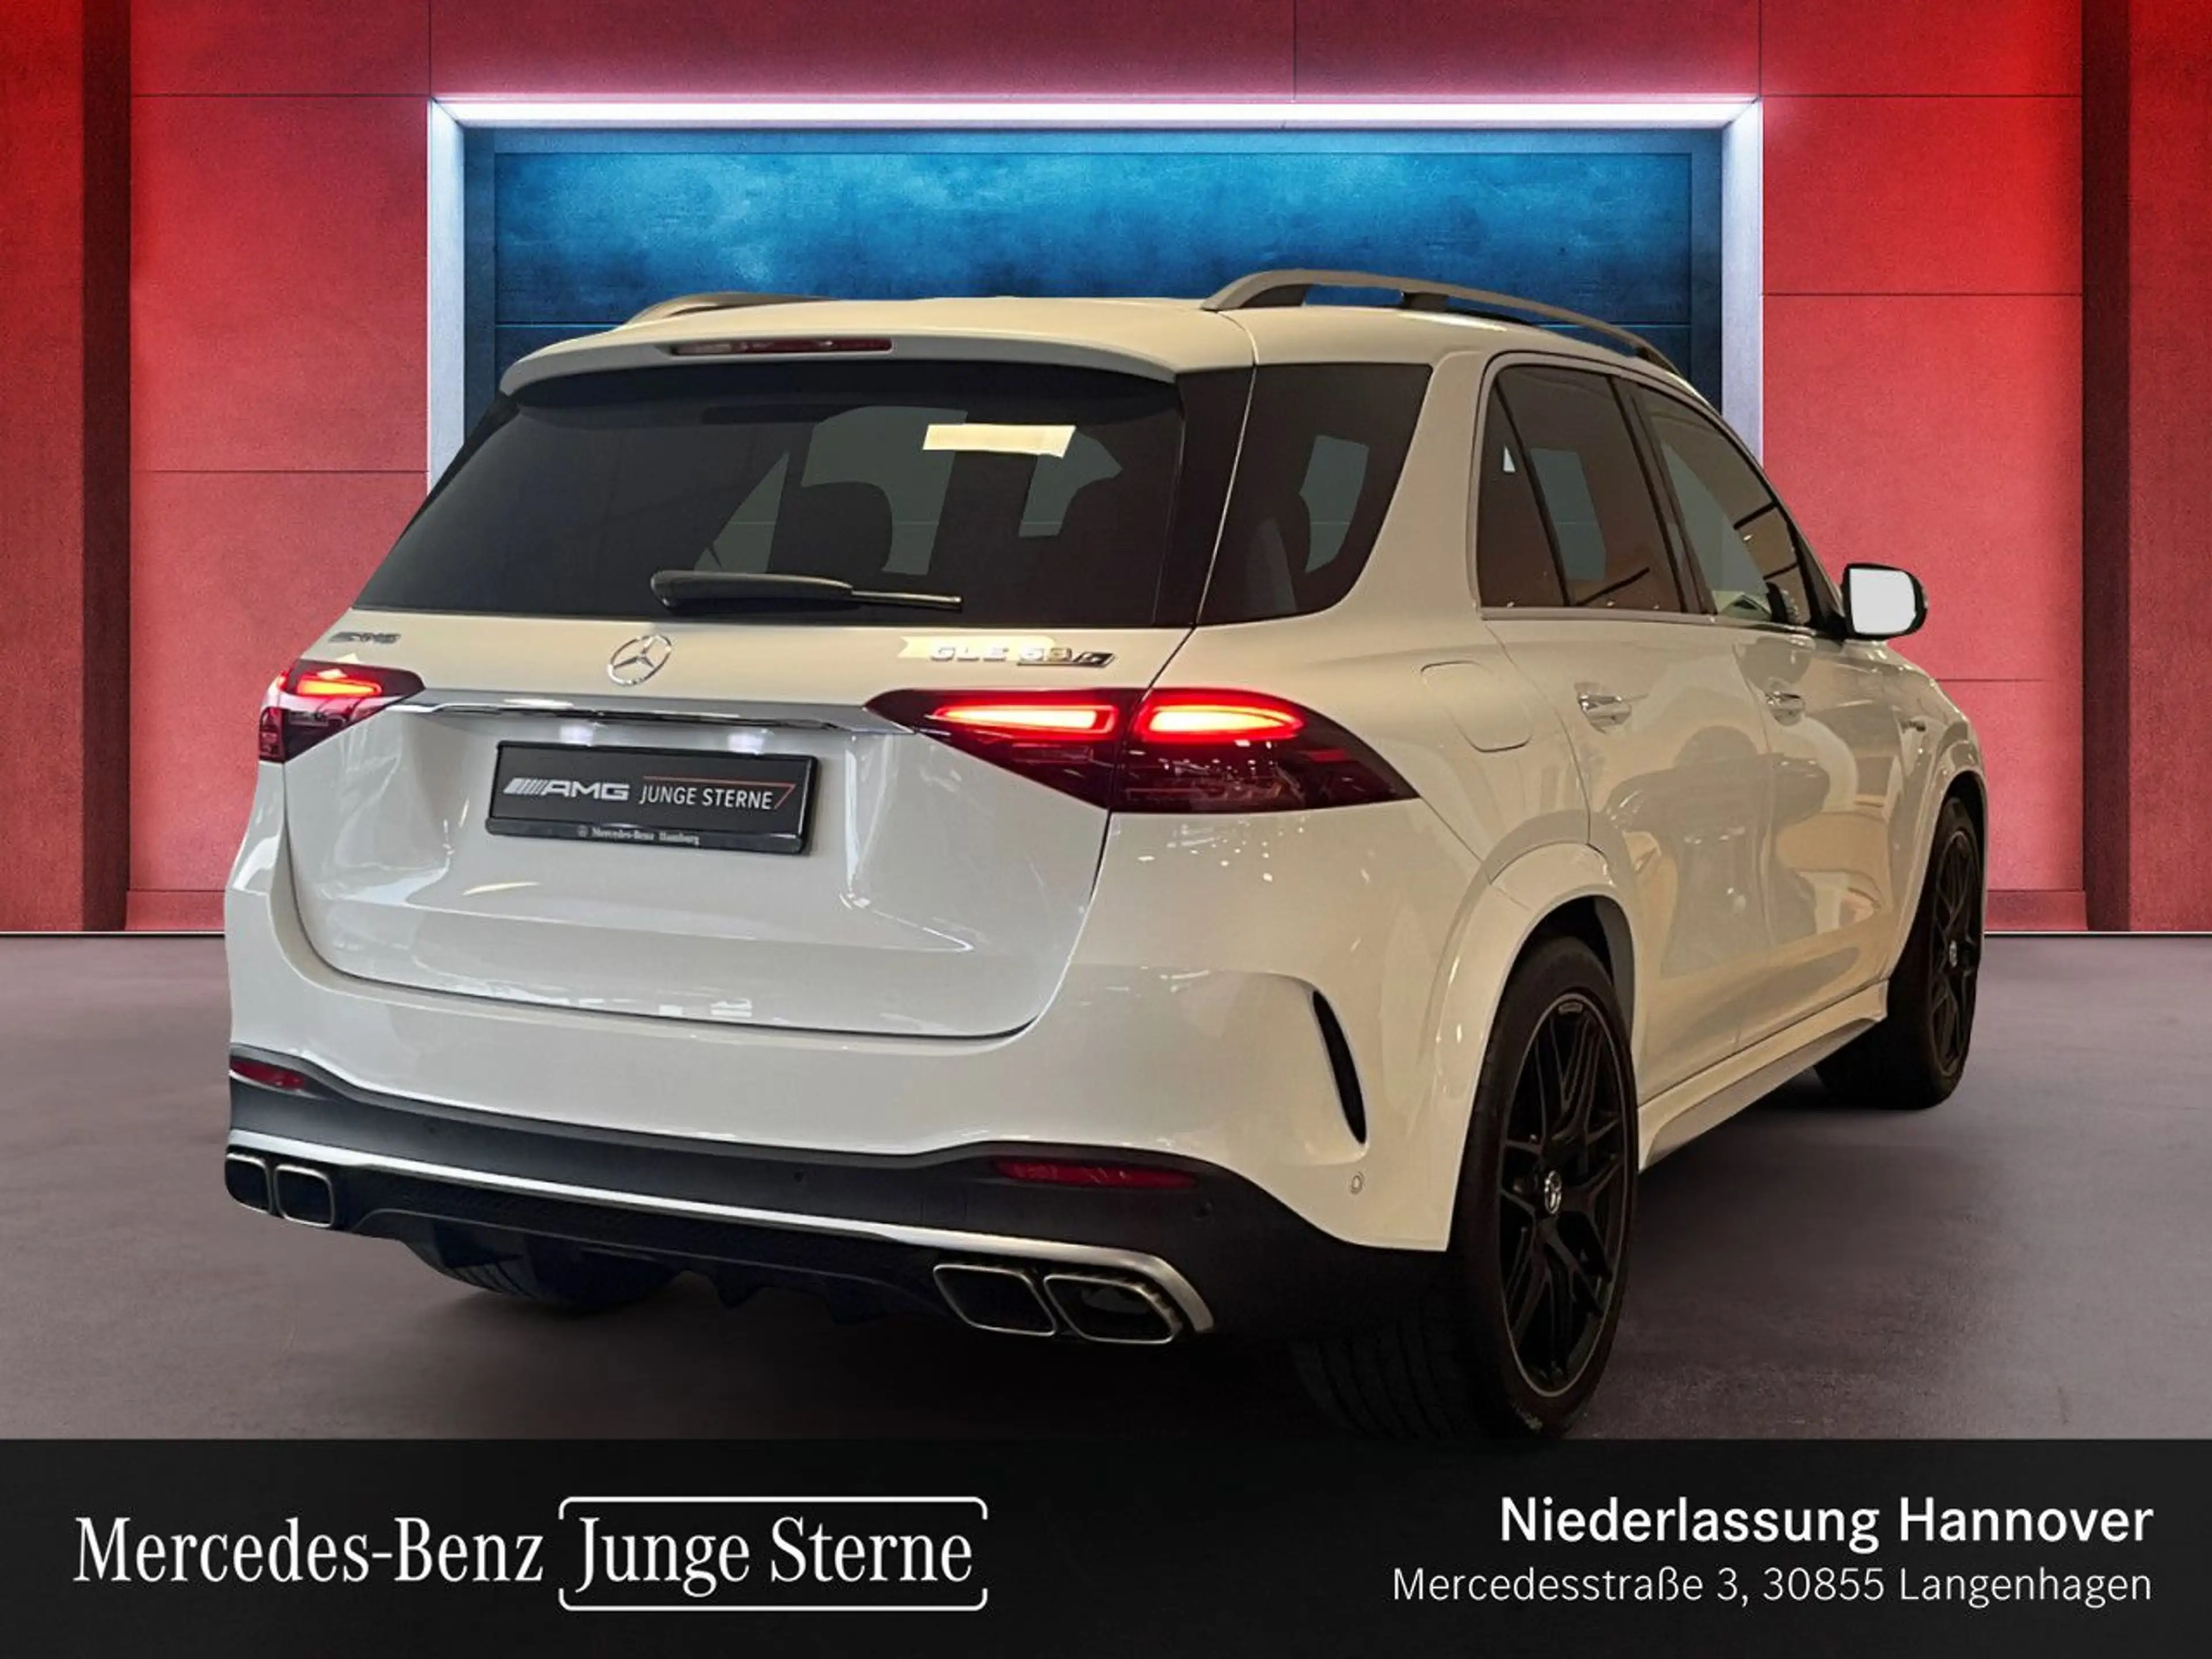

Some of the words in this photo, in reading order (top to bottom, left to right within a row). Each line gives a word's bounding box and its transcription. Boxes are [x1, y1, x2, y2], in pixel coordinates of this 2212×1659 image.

[540, 779, 630, 801] AMG
[638, 784, 698, 805] JUNGE
[702, 787, 774, 810] STERNE
